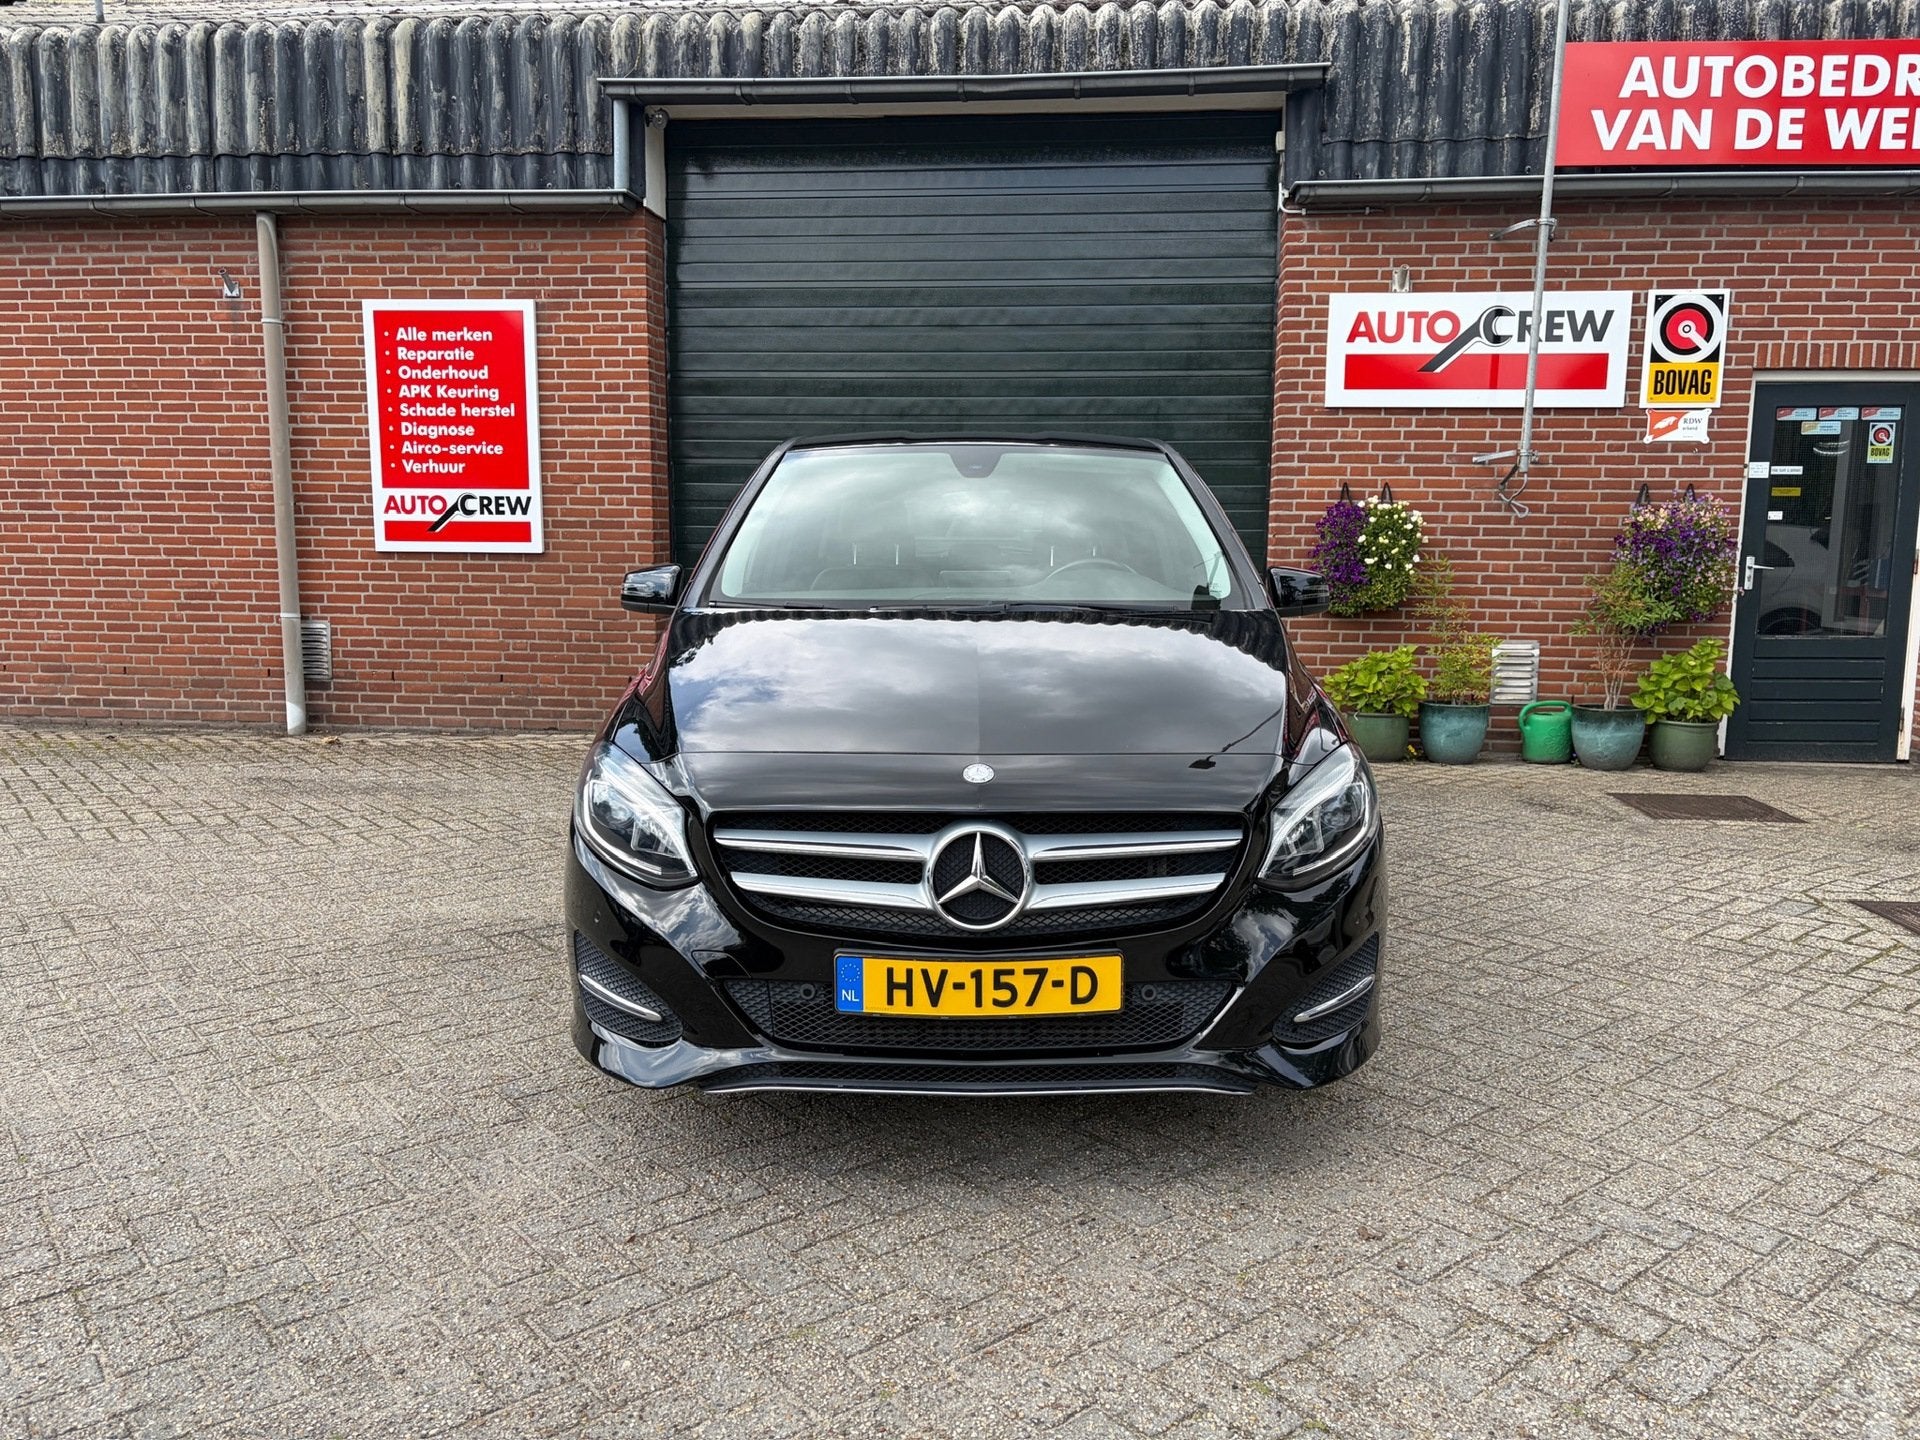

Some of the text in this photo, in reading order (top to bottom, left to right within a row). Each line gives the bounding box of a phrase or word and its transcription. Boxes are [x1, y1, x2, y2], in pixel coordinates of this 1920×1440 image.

[1617, 54, 1920, 98] AUTOBEDR
[1590, 107, 1920, 151] VAN DE WE
[1345, 304, 1615, 346] AUTO CREW
[396, 327, 493, 342] Alle merken
[397, 346, 475, 363] Reparatie
[398, 365, 489, 380] Onderhoud
[1653, 369, 1713, 396] BOVAG
[398, 384, 500, 401] APK Keuring
[399, 403, 515, 417] Schade herstel
[1683, 417, 1703, 425] RDW
[401, 422, 475, 438] Diagnose
[402, 441, 504, 455] Airco-service
[1870, 447, 1890, 457] BOVAG
[402, 459, 466, 474] Verhuur
[383, 494, 532, 517] AUTO CREW
[886, 965, 1099, 1008] HV-157-D
[841, 989, 860, 1002] NL
